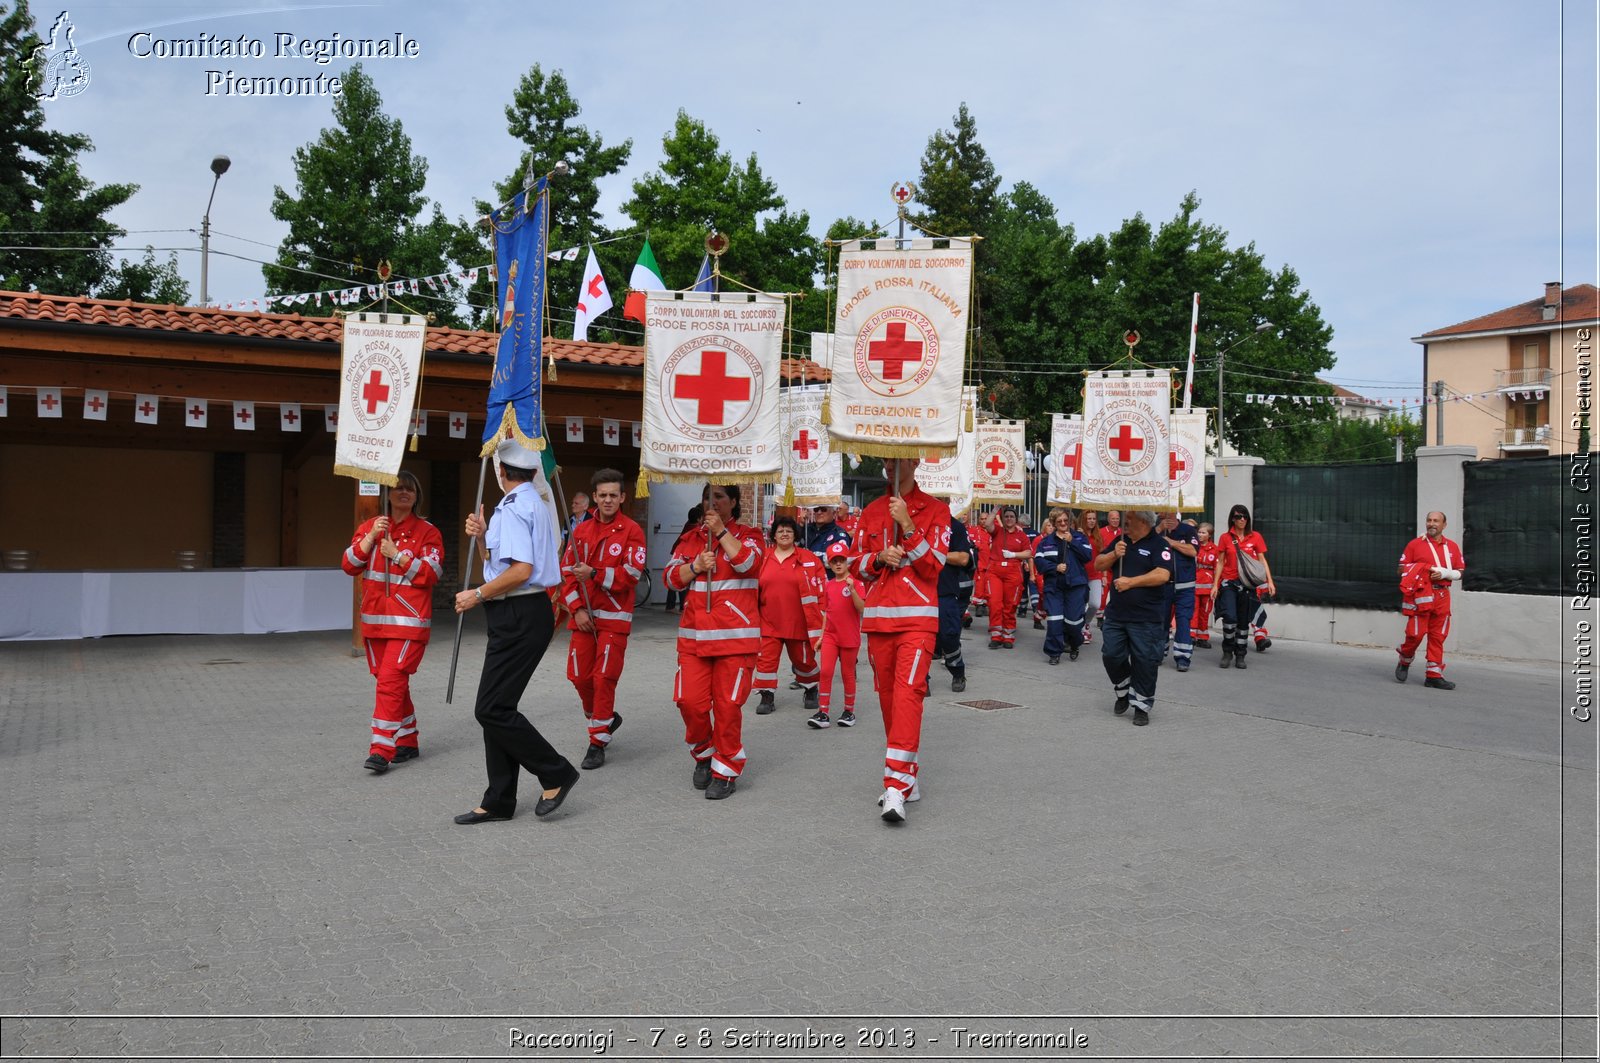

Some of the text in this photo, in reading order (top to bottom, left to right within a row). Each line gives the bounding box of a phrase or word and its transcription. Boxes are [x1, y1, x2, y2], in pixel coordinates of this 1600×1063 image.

[844, 257, 965, 269] CORPO VOLONTARI DEL SOCCORSO
[840, 276, 962, 318] CROCE ROSSA ITALIANA
[653, 306, 777, 320] CORPO VOLONTARI DEL SOCCORSO
[647, 317, 783, 333] CROCE ROSSA ITALIANA
[856, 308, 938, 384] CONVENZIONE DI GINEVRA 22 AGOSTO 1864
[345, 340, 411, 388] CROCE ROSSA ITALIANA
[664, 337, 763, 378] CONVENZIONE DI GINEVRA
[390, 365, 399, 376] 22
[846, 404, 939, 419] DELEGAZIONE DI
[1085, 399, 1168, 439] CROCE ROSSA ITALIANA
[855, 423, 921, 438] PAESANA
[651, 441, 766, 456] COMITATO LOCALE DI
[668, 457, 752, 470] RACCONIGI
[917, 481, 953, 489] ORETTA
[1087, 478, 1122, 486] COMITATO
[1124, 479, 1155, 488] LOCALE
[1082, 487, 1111, 495] BORGO
[1122, 488, 1167, 498] DALMAZZO
